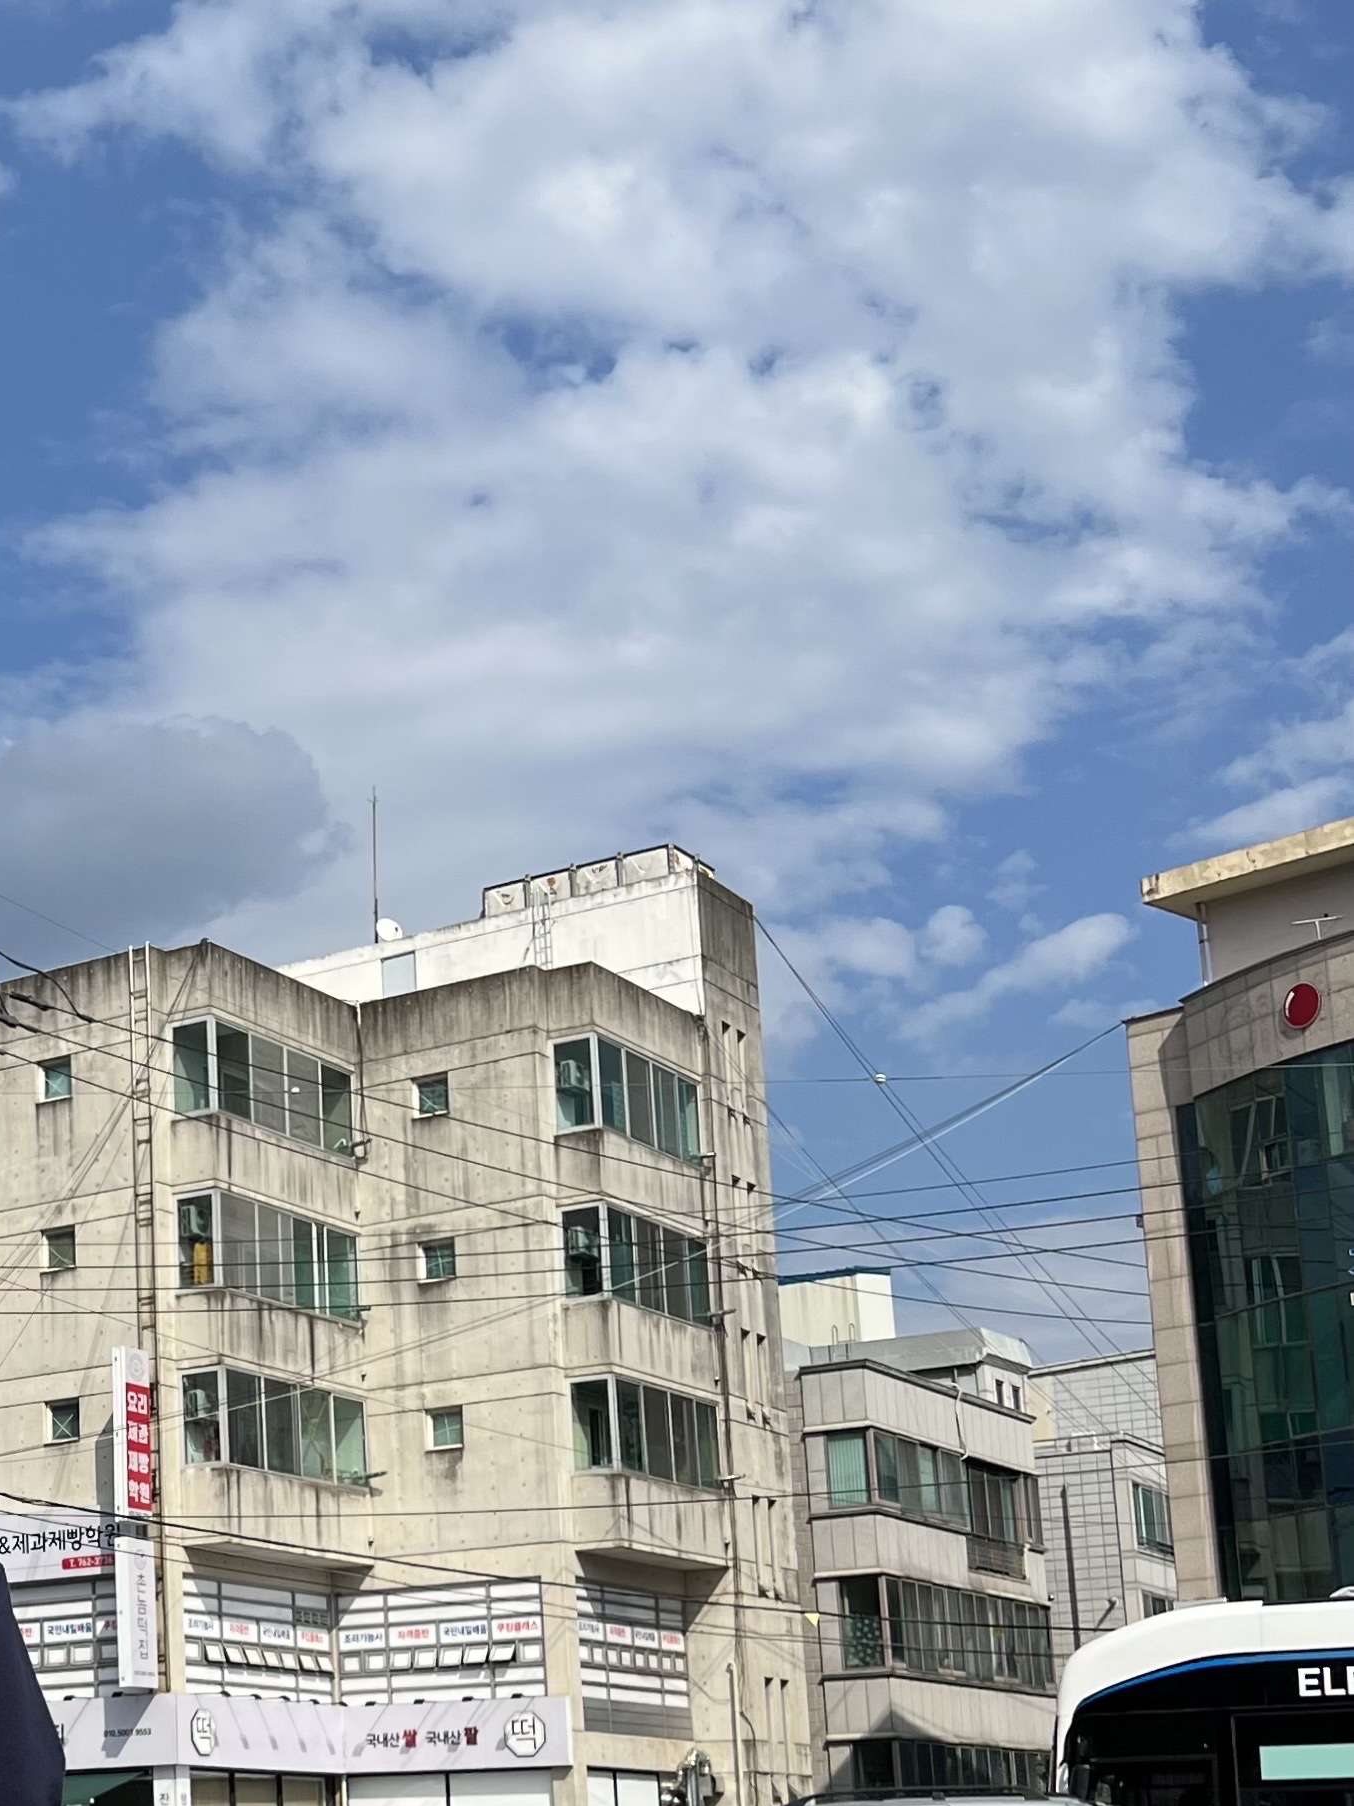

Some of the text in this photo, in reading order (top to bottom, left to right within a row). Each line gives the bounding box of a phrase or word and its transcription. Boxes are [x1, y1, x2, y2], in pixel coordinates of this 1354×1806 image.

[127, 1391, 148, 1415] 요리
[128, 1450, 150, 1474] 제빵
[128, 1479, 150, 1504] 학원
[366, 1733, 400, 1748] 국내산
[425, 1730, 461, 1747] 국내산
[511, 1716, 537, 1750] 떡
